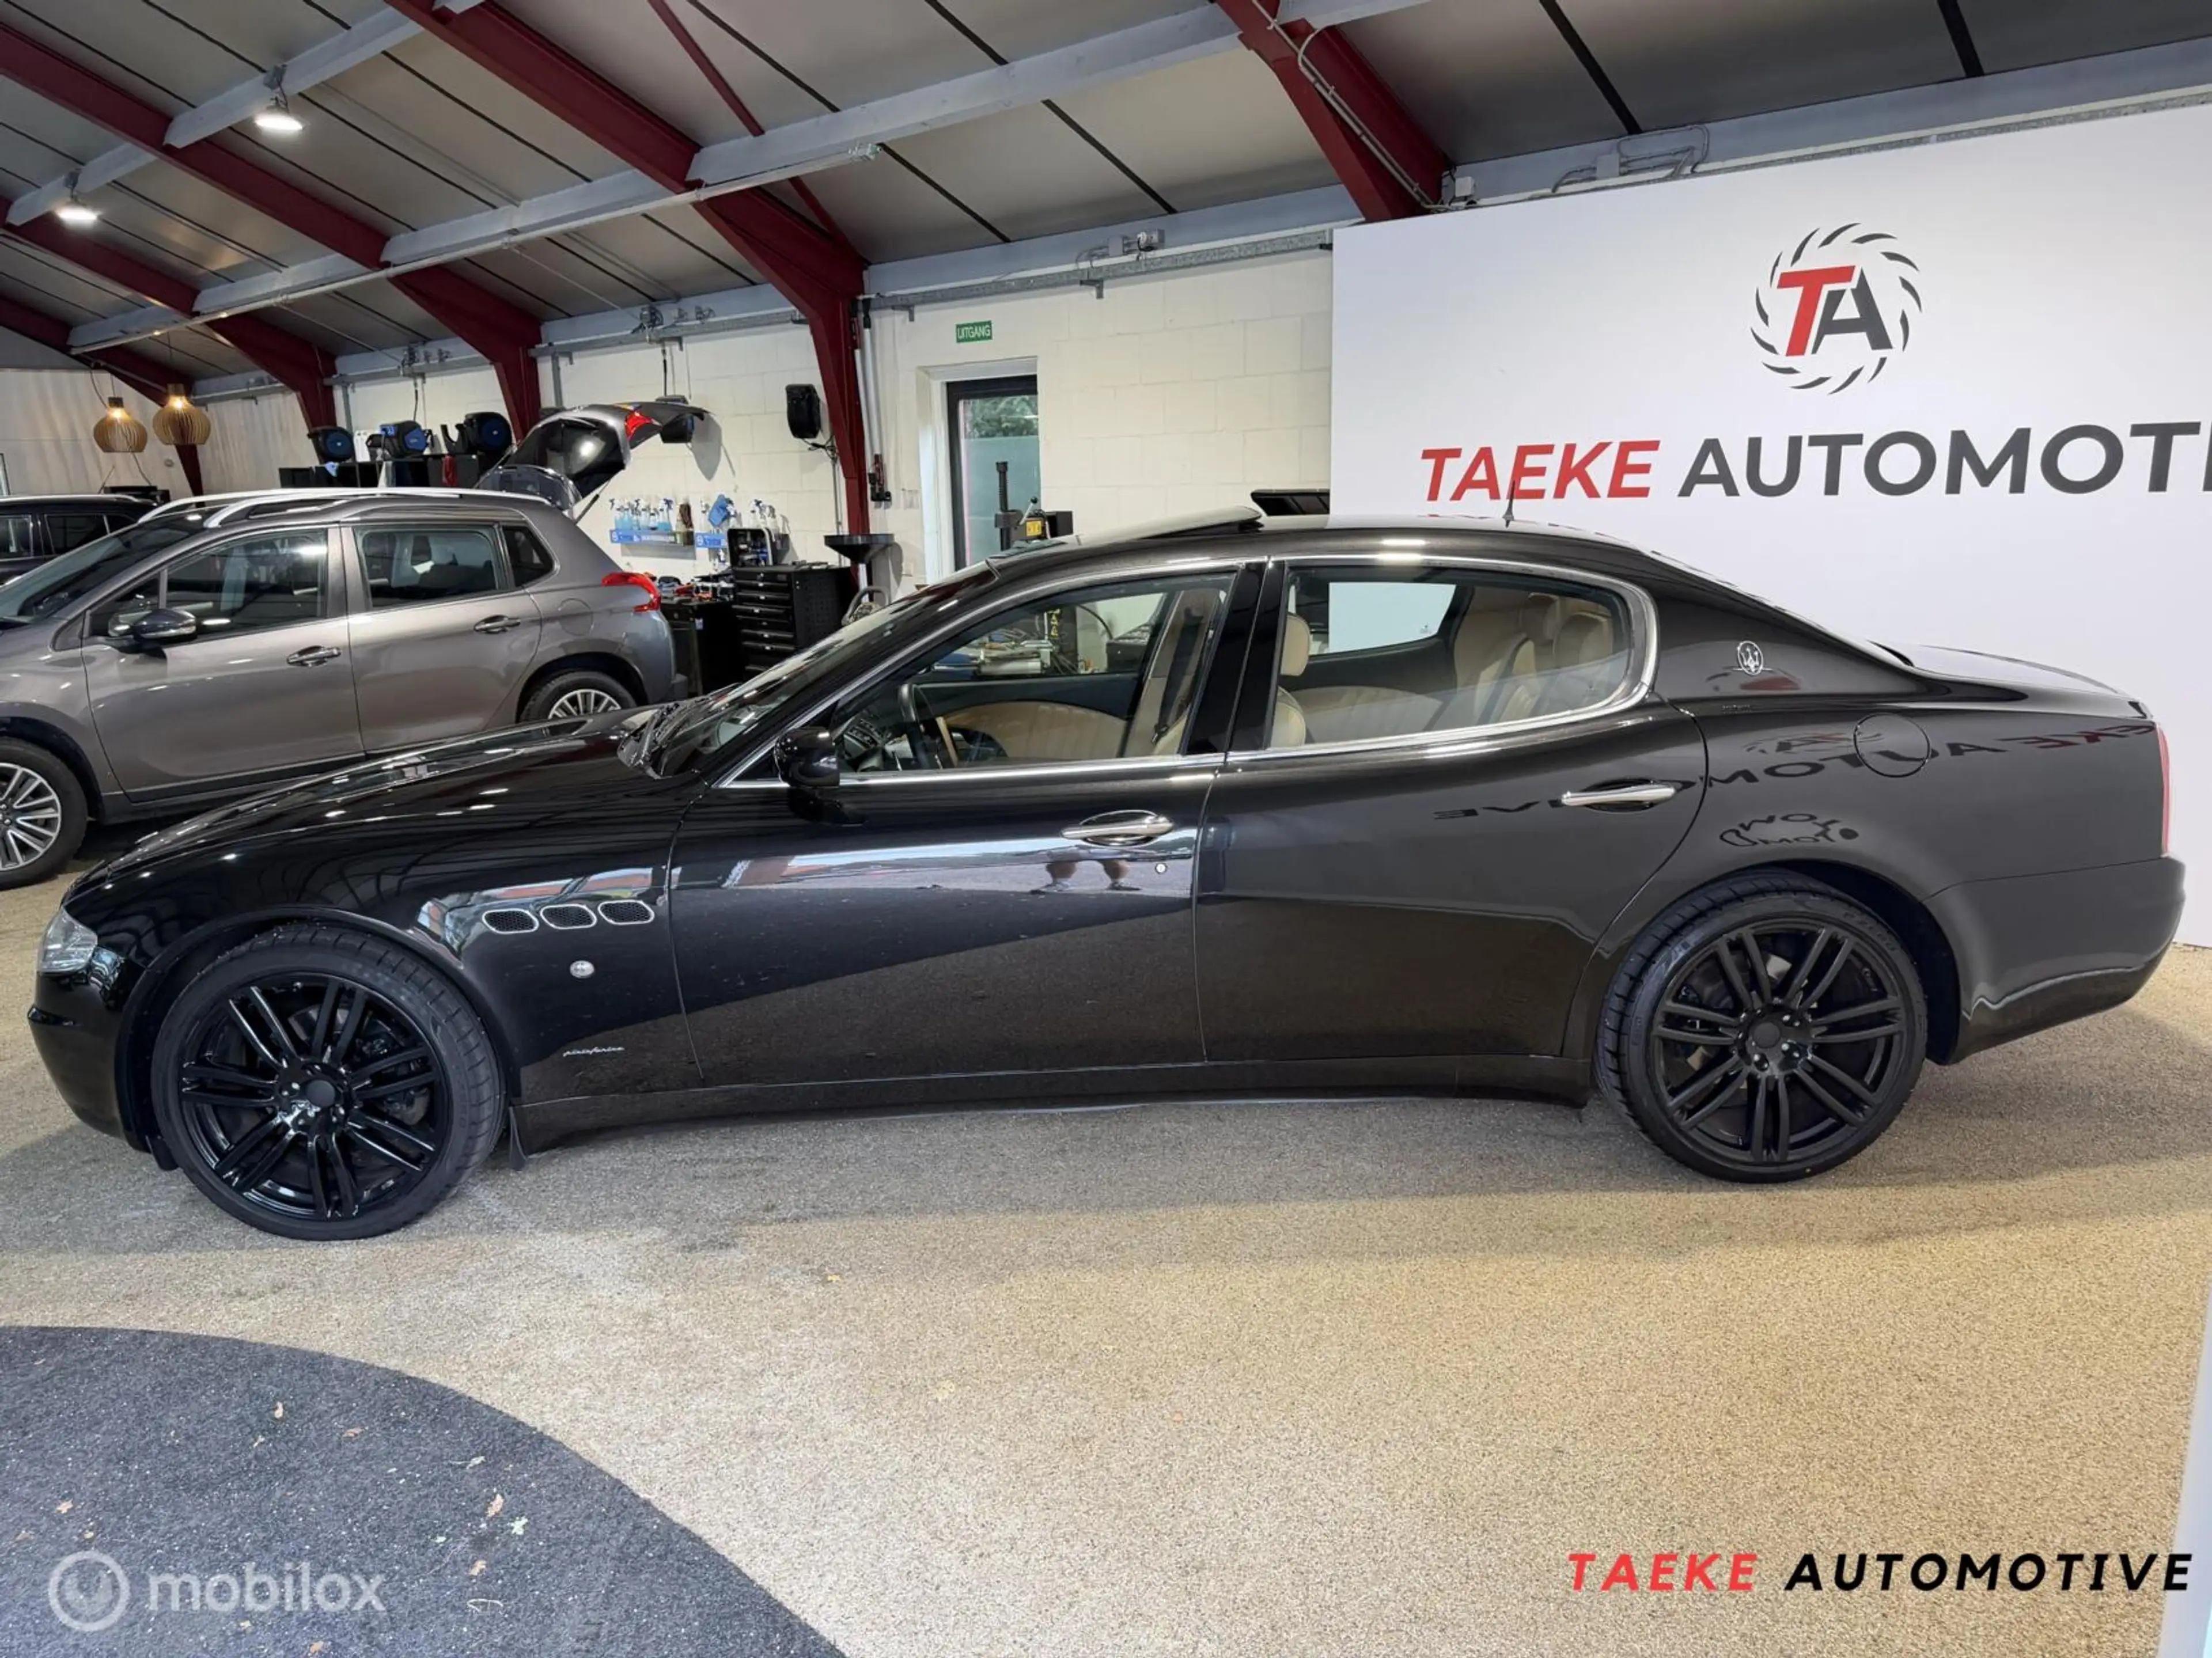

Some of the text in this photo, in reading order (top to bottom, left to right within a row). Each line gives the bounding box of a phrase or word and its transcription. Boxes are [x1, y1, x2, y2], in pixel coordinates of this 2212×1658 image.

[957, 325, 991, 339] UITGANG
[1777, 265, 1893, 356] TA
[1421, 421, 2212, 501] TAEKE AUTOMOT
